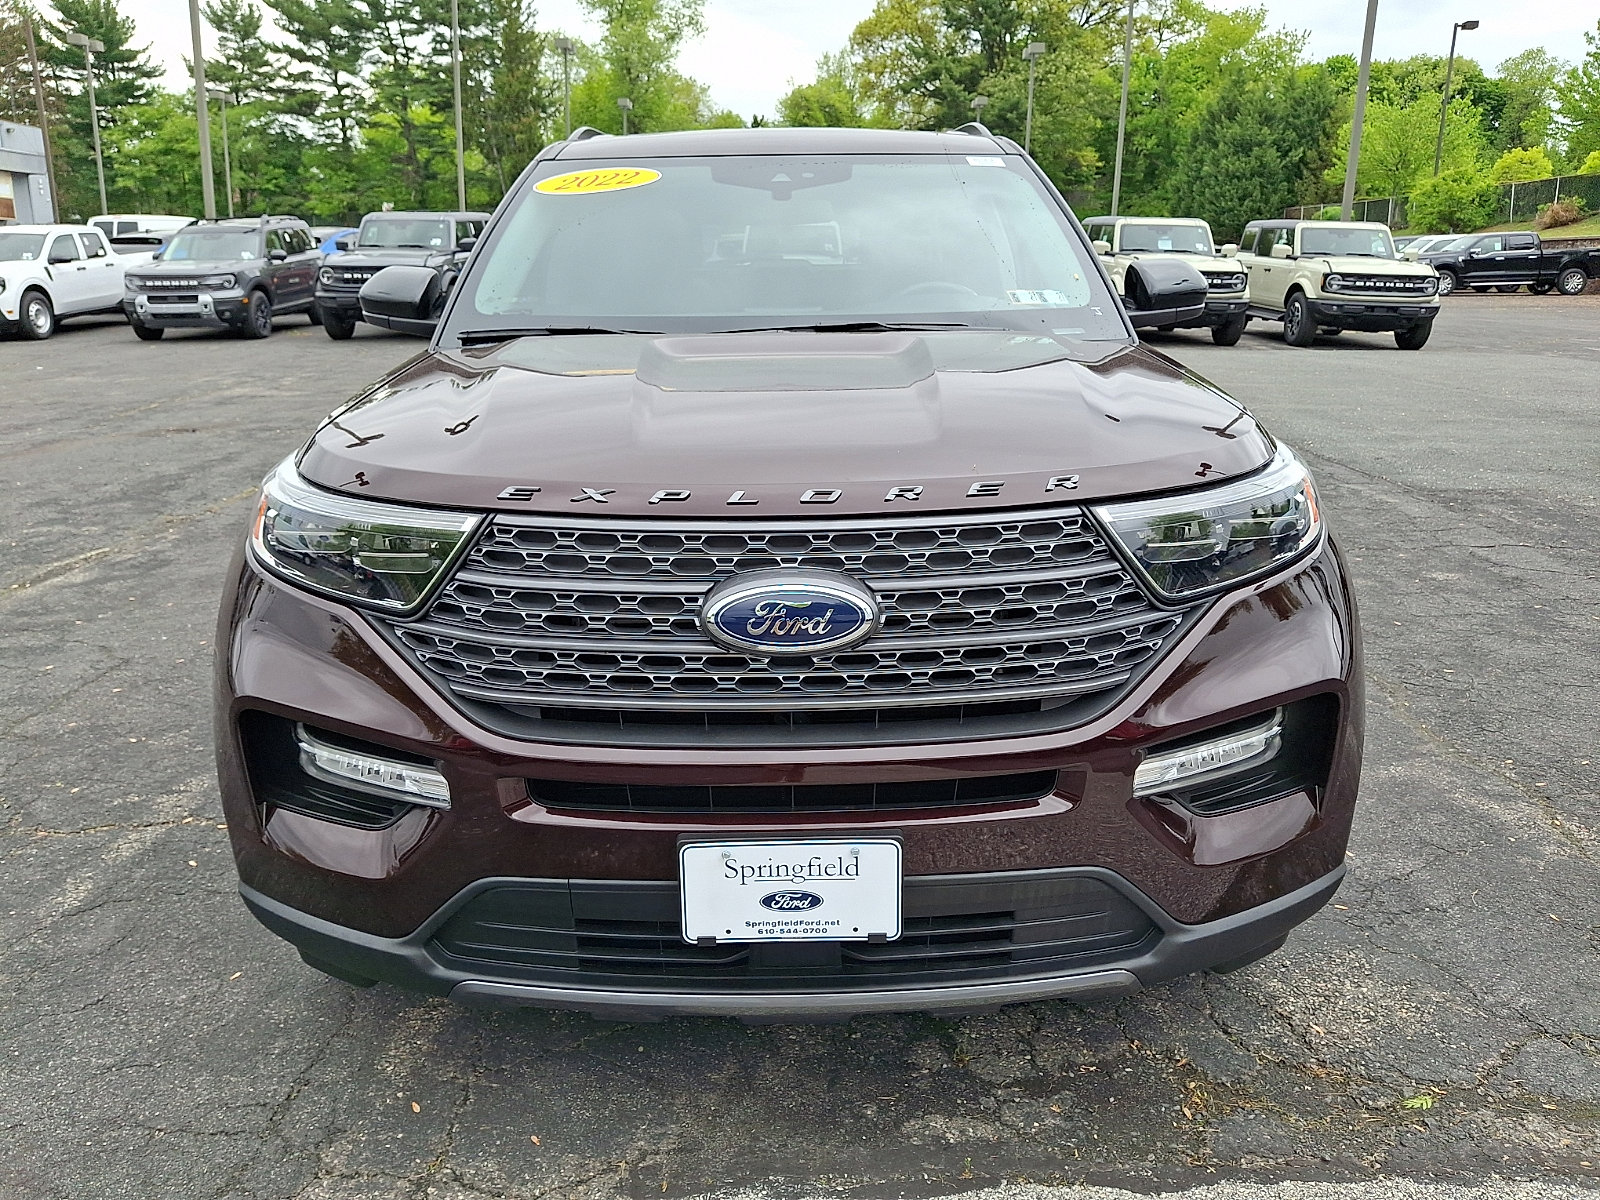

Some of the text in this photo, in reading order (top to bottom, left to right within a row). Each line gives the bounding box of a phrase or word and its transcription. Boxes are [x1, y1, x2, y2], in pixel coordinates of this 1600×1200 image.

[554, 171, 640, 190] 2022
[496, 474, 1080, 505] EXPLORER
[747, 599, 834, 636] Ford
[724, 857, 859, 885] Springfield
[770, 892, 811, 909] Ford
[745, 919, 840, 928] SpringfieldFord.net
[757, 927, 828, 935] 610-544-0700
